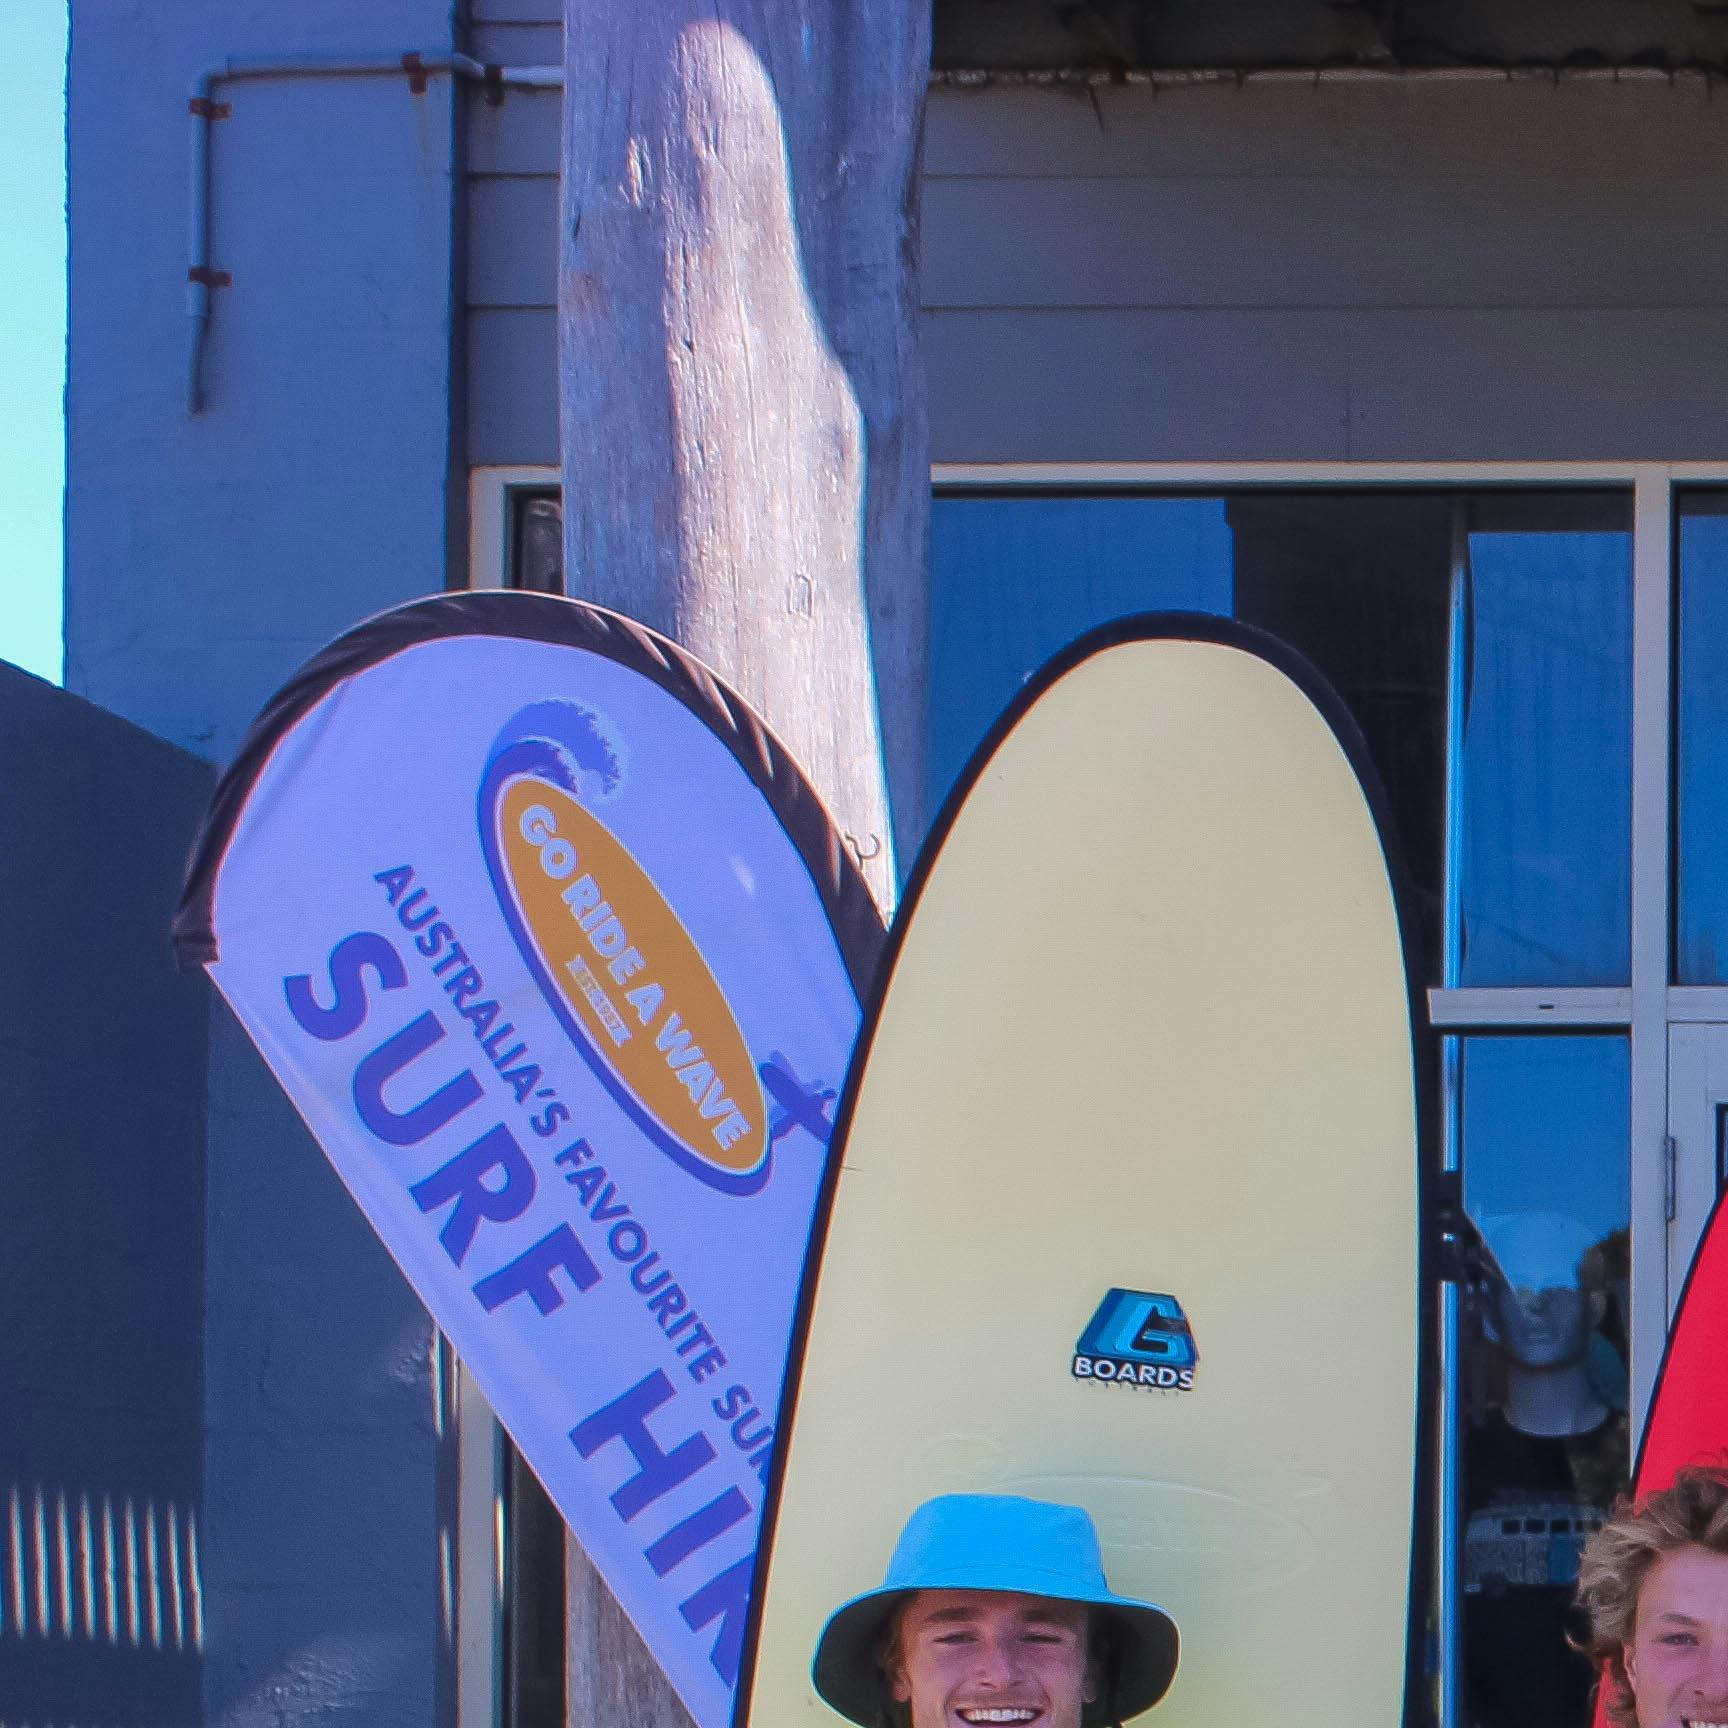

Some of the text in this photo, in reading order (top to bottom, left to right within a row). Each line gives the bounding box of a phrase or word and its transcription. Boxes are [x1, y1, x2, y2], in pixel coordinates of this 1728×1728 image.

[283, 931, 602, 1317] SURF
[374, 864, 570, 1138] AUSTRALIA'S
[555, 1136, 726, 1385] FAVOURITE
[517, 804, 579, 880] GO
[560, 880, 647, 986] RIDE
[626, 983, 662, 1026] A
[655, 1016, 752, 1151] WAVE
[1074, 1356, 1195, 1390] BOARDS
